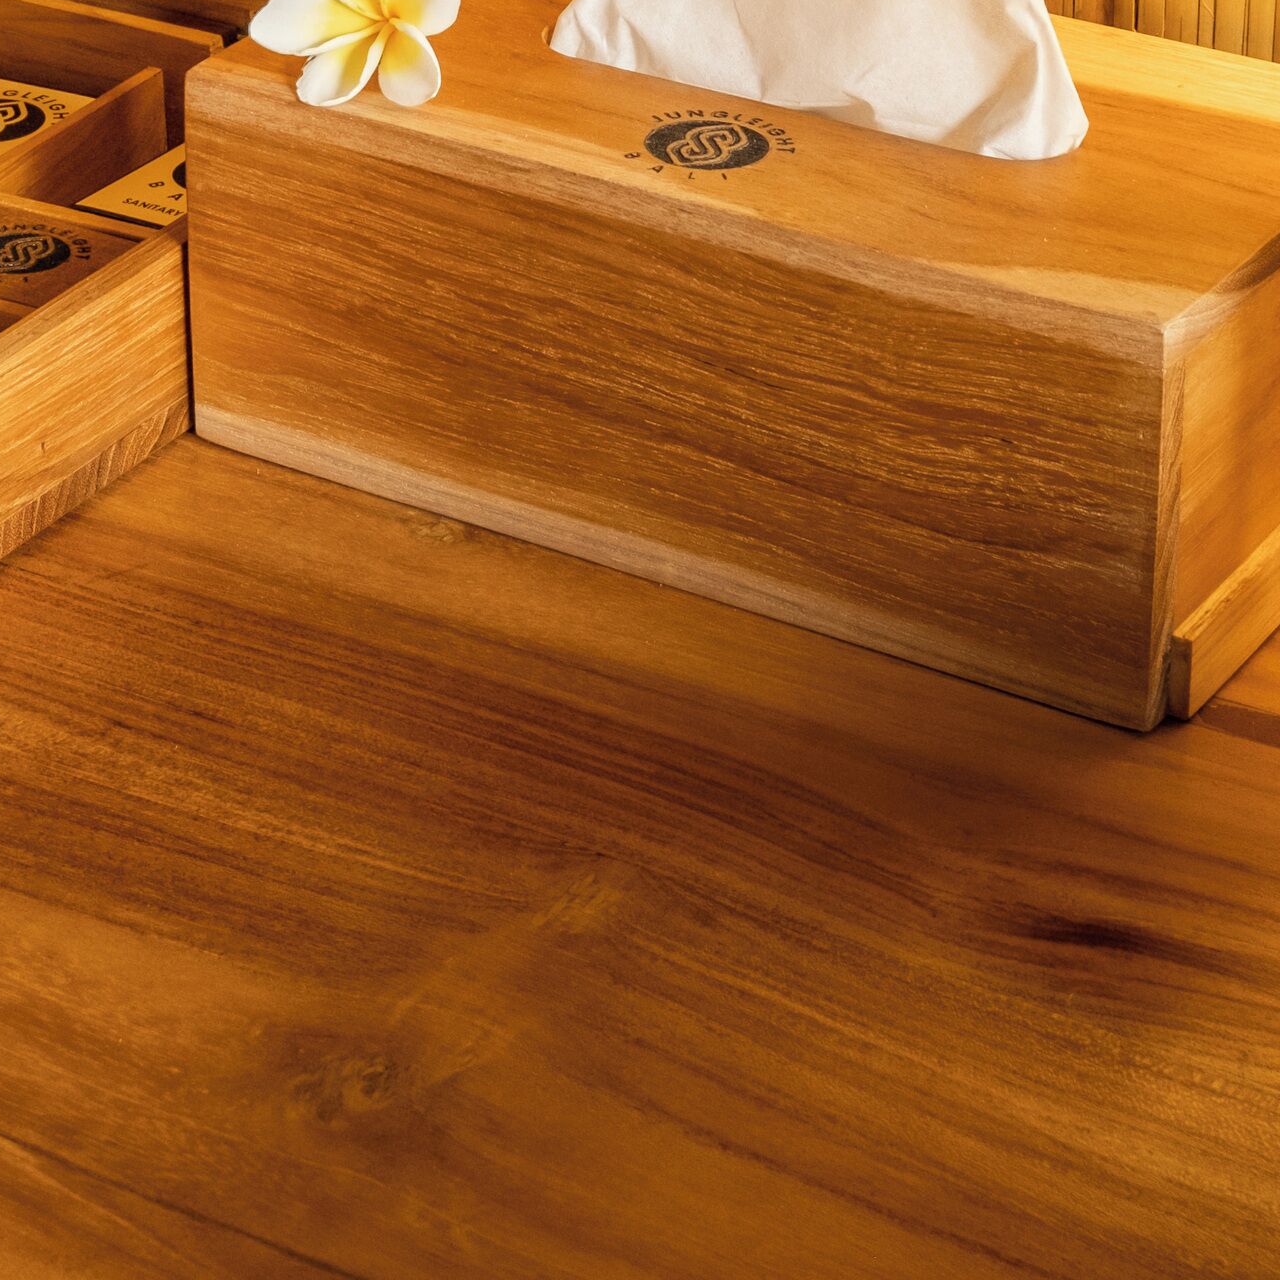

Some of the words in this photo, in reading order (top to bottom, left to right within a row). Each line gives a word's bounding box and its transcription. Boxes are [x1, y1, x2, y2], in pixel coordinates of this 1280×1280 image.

[651, 109, 796, 154] JUNGLEIGHT
[624, 151, 728, 180] BALI
[122, 198, 184, 217] SANITARY
